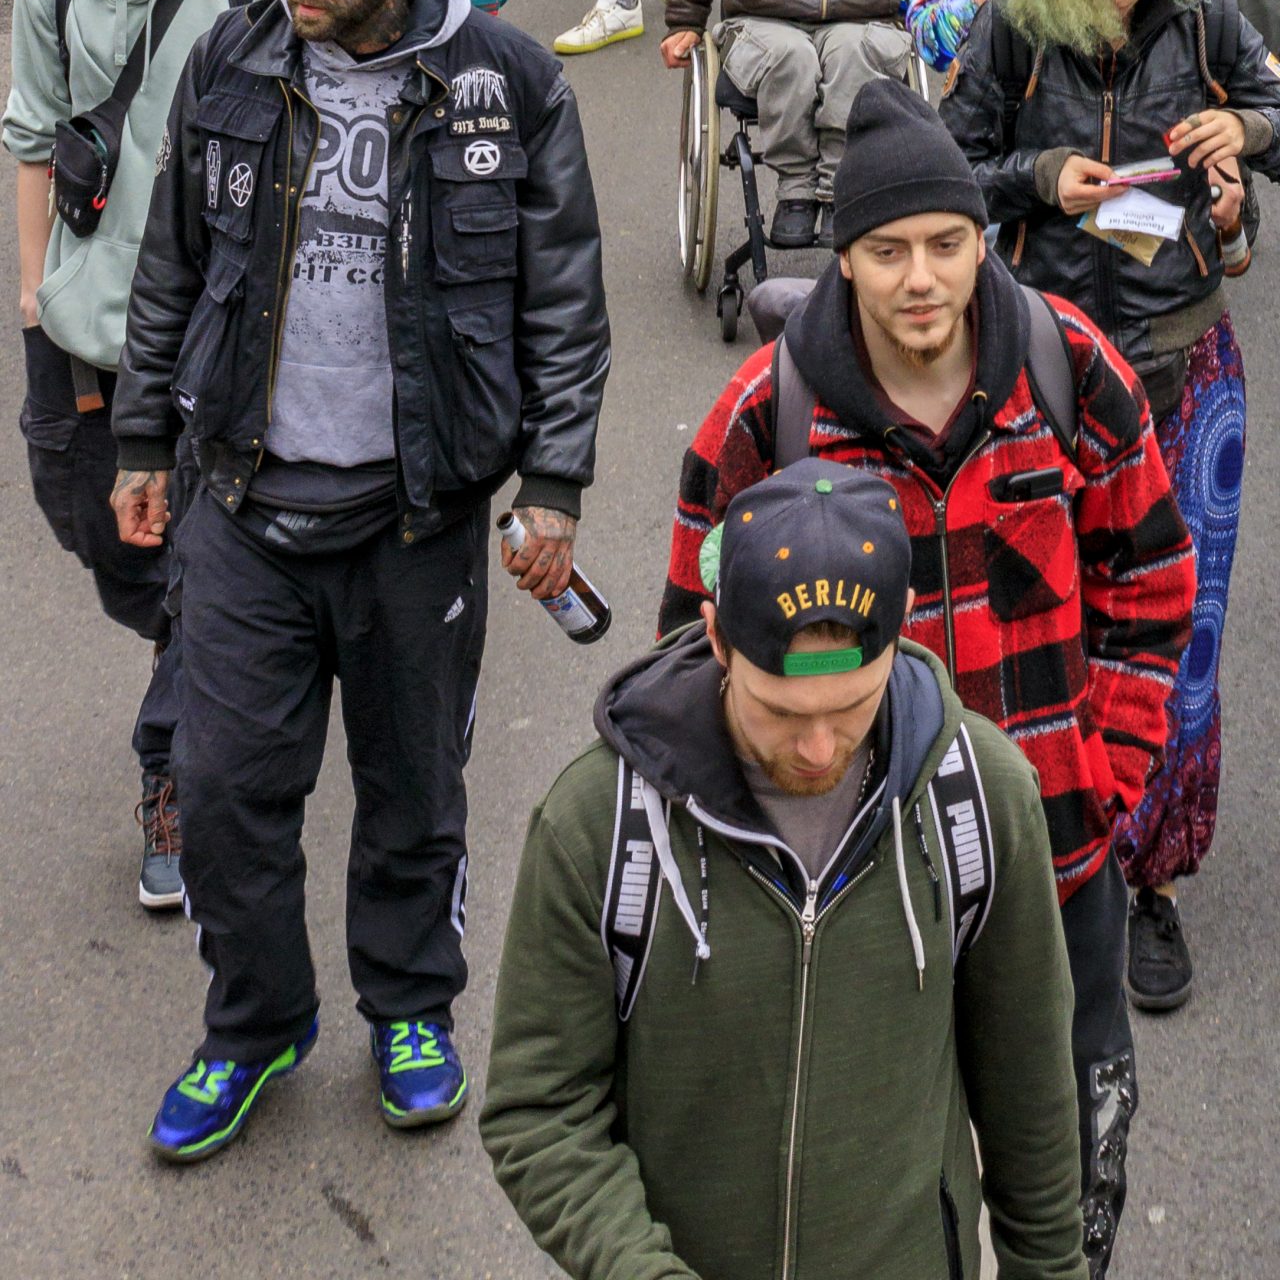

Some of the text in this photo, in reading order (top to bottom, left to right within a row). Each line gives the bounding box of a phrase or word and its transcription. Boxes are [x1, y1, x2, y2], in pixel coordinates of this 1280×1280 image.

[1123, 218, 1165, 233] Rauchen
[776, 577, 876, 620] BERLIN
[946, 799, 986, 896] PUMA
[613, 839, 654, 938] PUMA
